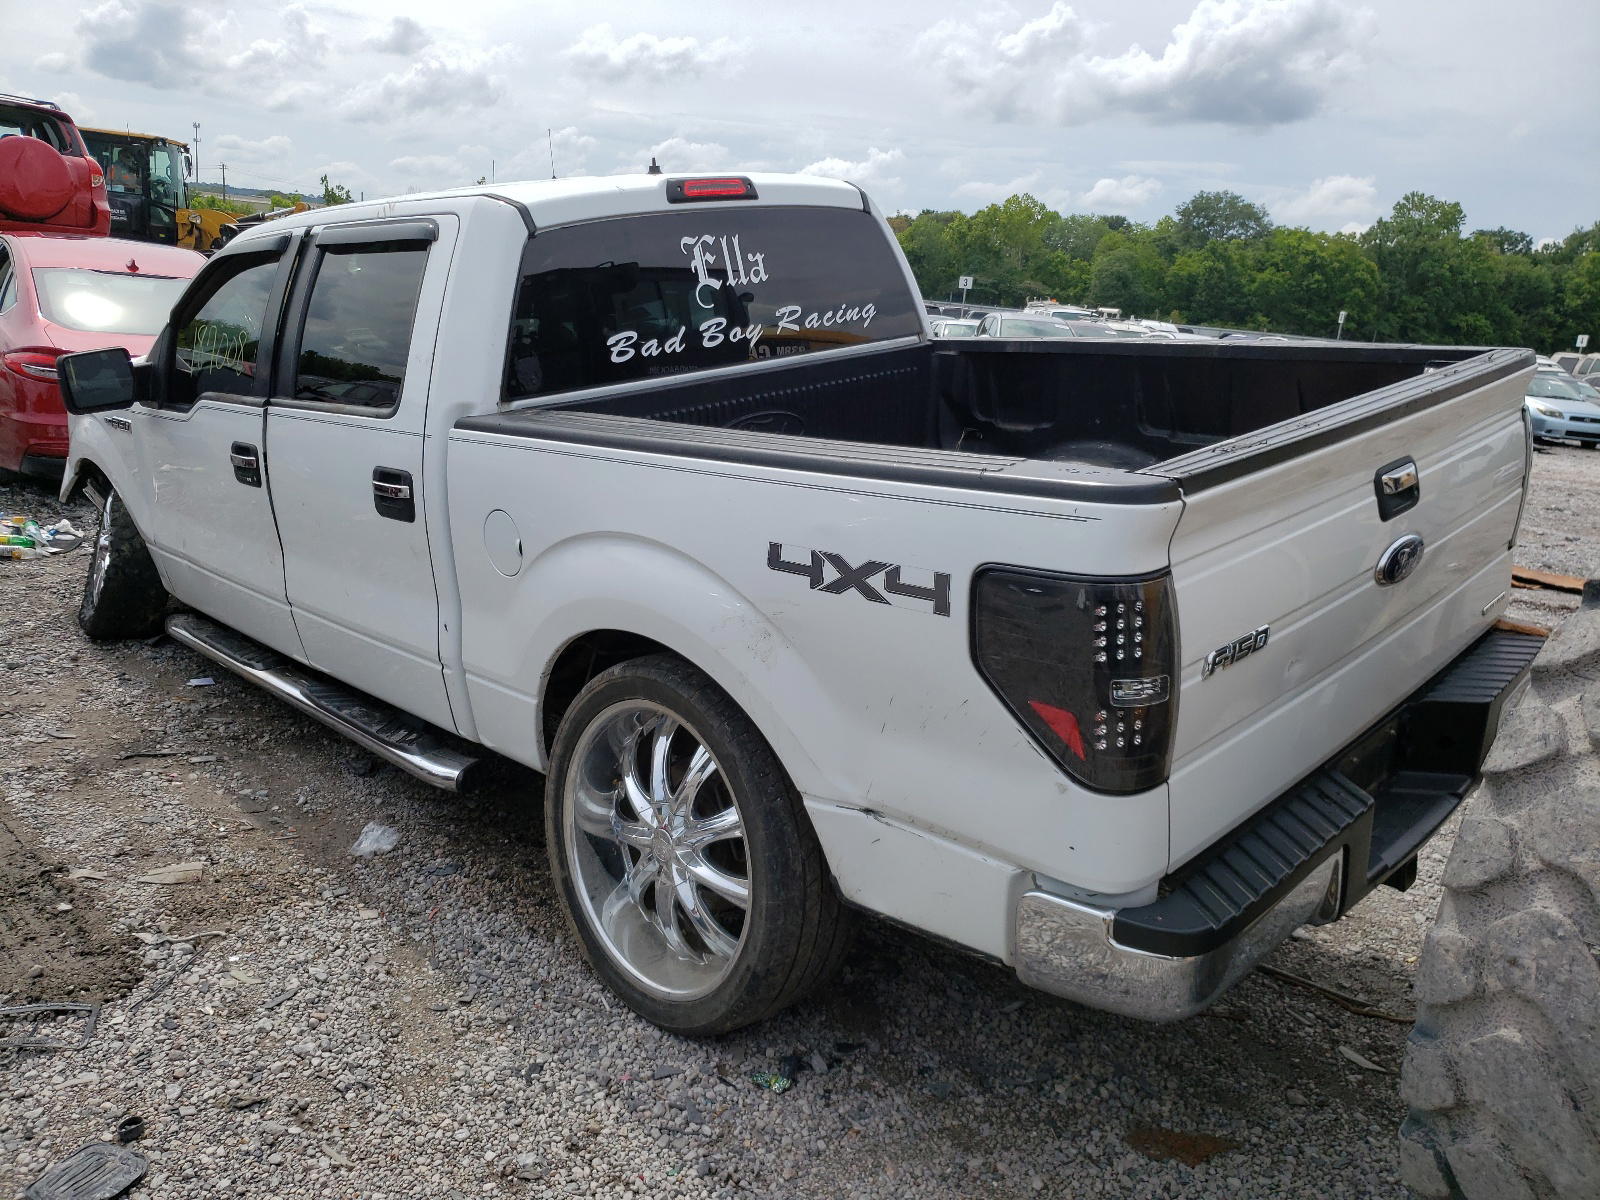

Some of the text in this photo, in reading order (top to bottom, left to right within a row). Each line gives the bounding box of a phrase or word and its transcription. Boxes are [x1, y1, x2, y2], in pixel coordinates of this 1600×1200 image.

[680, 234, 769, 309] Ella
[606, 303, 877, 364] Bad Boy Racing
